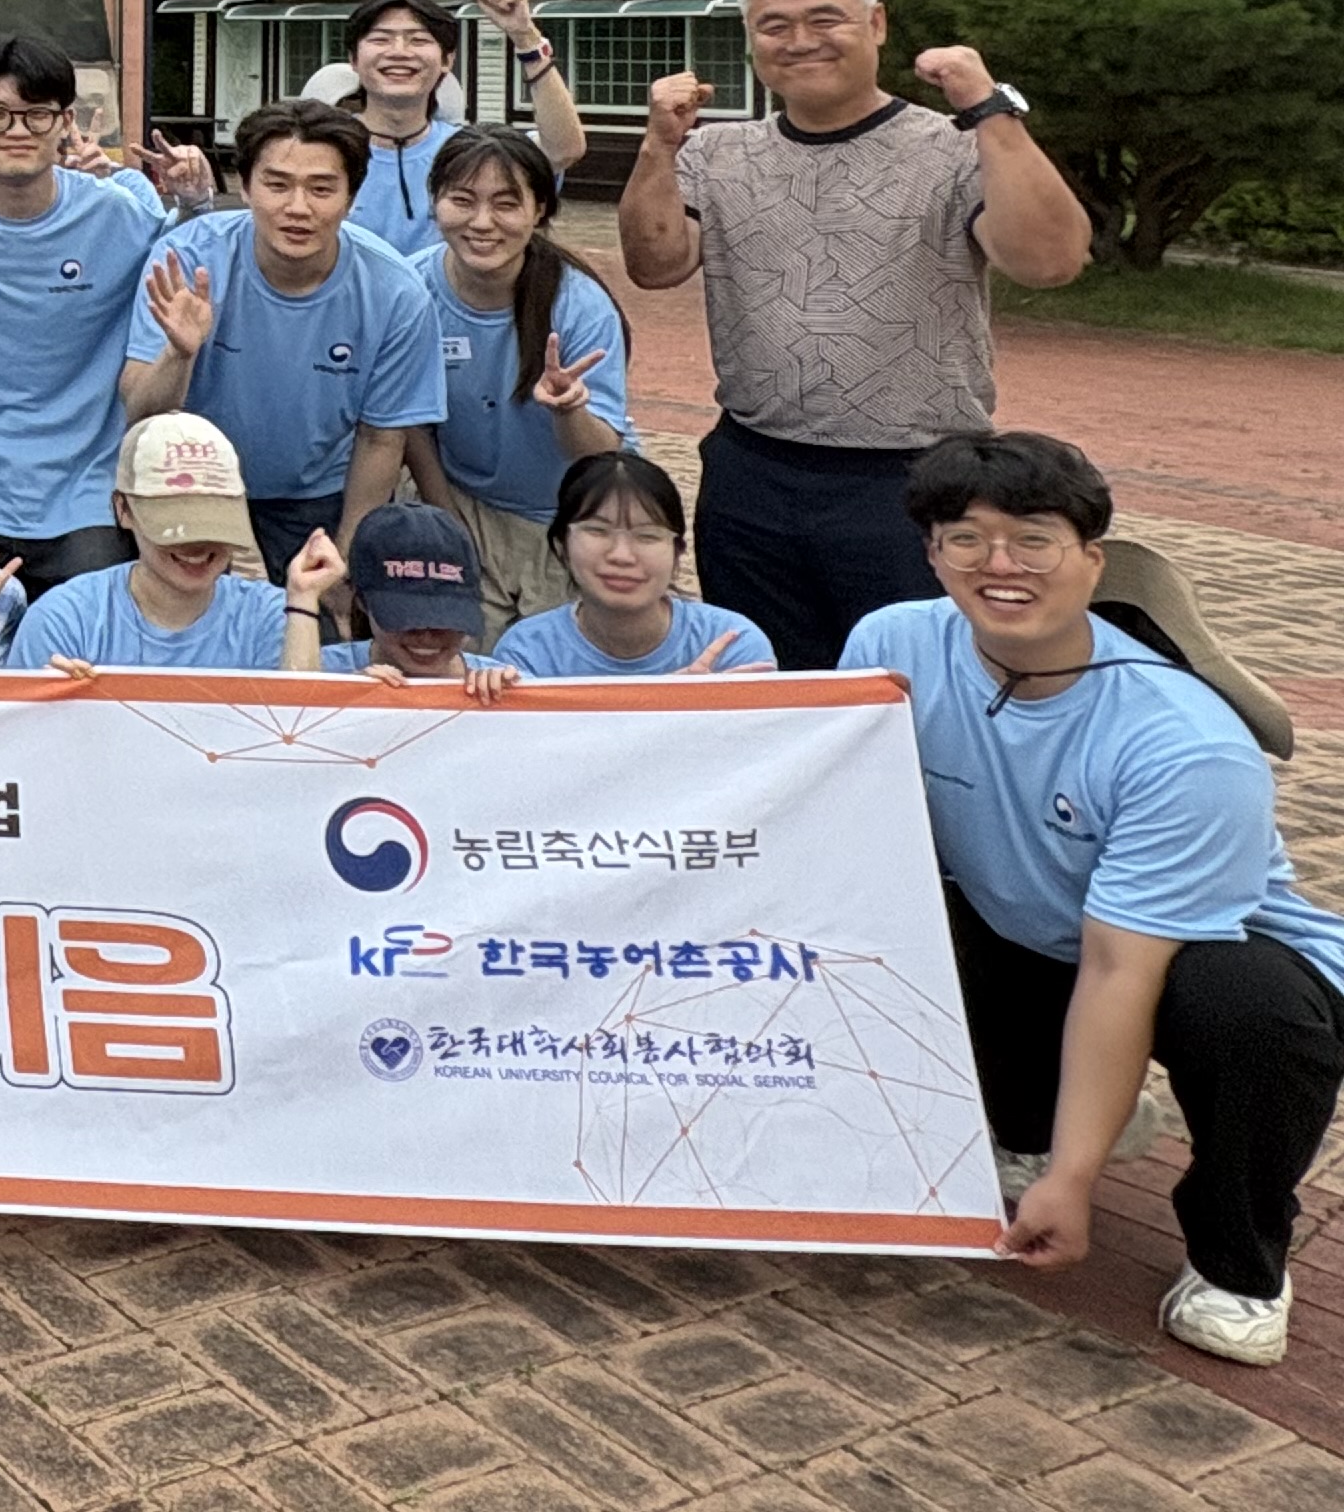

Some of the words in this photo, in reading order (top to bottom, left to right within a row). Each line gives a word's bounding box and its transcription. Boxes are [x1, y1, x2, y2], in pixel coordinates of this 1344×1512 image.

[453, 828, 761, 872] 농림축산식품부
[477, 938, 816, 983] 한국농어촌공사
[427, 1025, 816, 1070] 한국대학사회봉사협의회
[433, 1065, 492, 1081] KOREAN
[498, 1067, 582, 1082] UNIVERSITY
[588, 1070, 653, 1086] COUNCIL
[659, 1072, 689, 1087] FOR
[695, 1073, 748, 1088] SOCIAL
[753, 1074, 817, 1089] SERVICE
